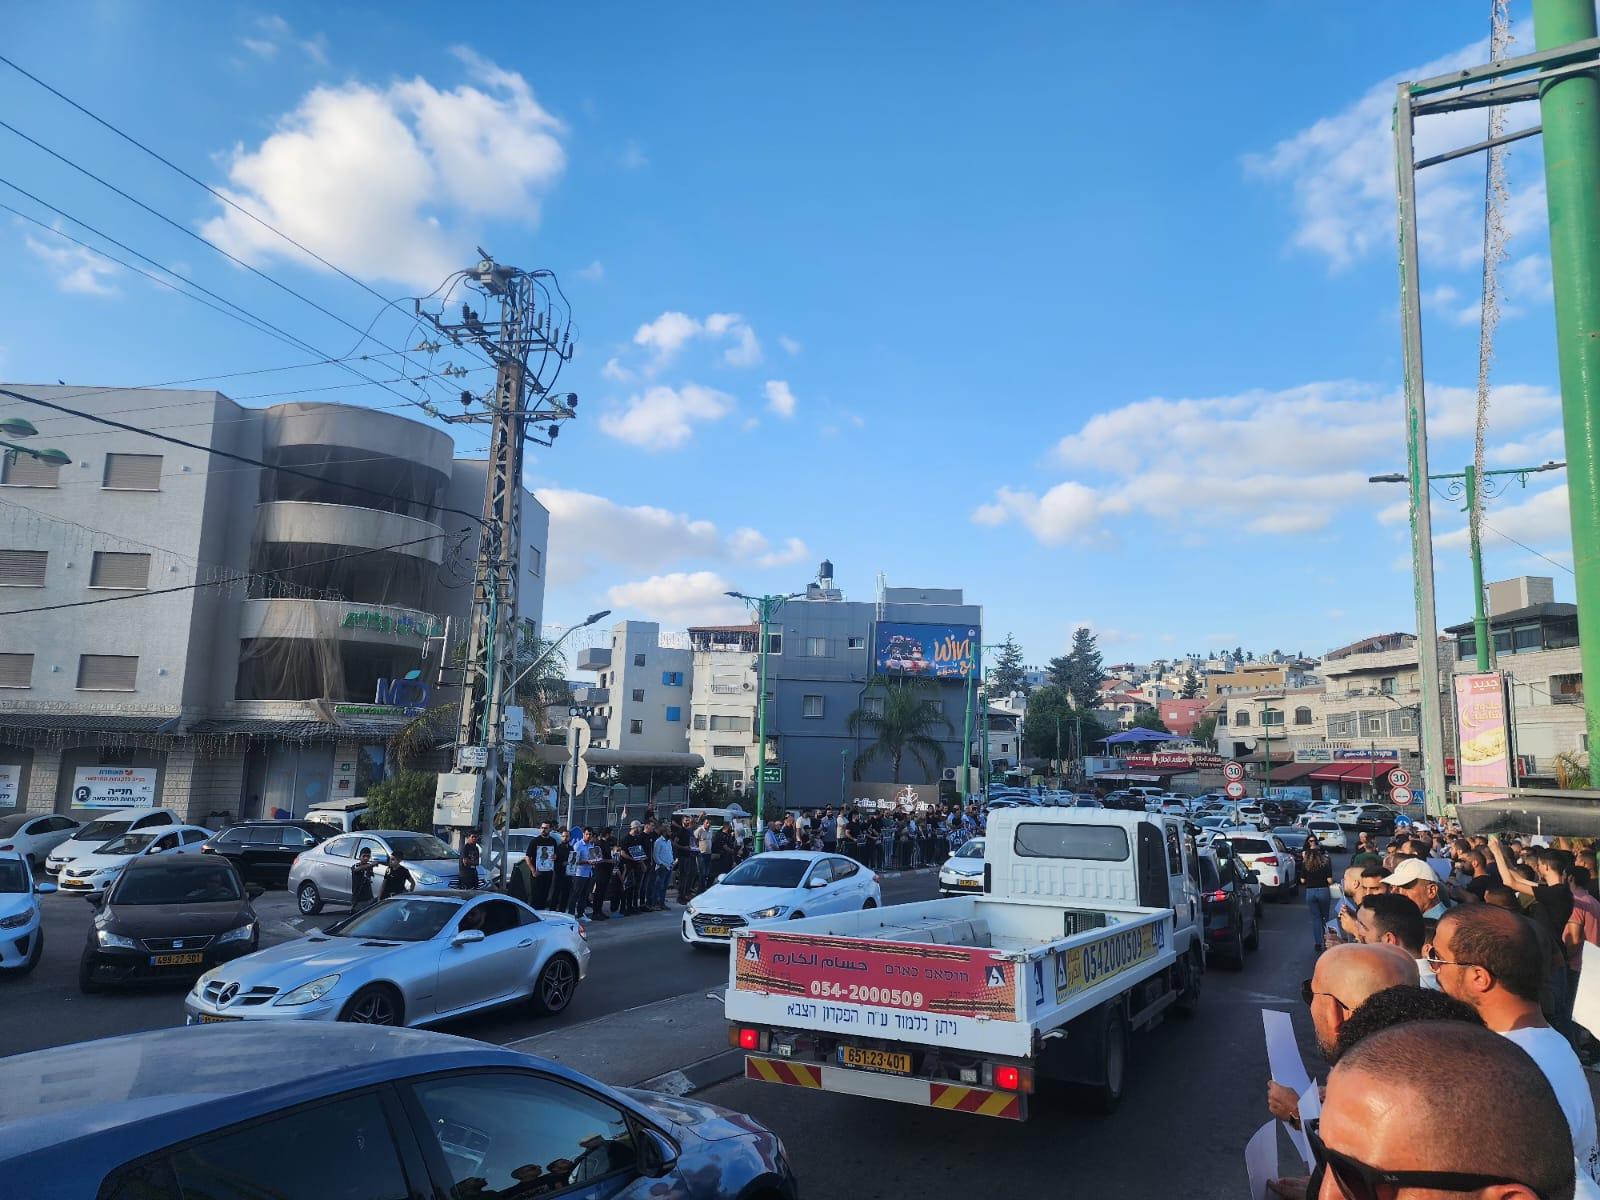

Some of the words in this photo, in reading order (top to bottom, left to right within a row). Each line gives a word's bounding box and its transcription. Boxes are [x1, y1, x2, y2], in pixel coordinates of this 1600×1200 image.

[934, 634, 970, 662] Win
[1473, 679, 1498, 691] جديد
[1228, 767, 1240, 776] 30
[1392, 773, 1406, 783] 30
[107, 787, 133, 796] חנייה
[772, 951, 818, 966] الكارم
[821, 956, 868, 971] حسام
[1083, 928, 1142, 984] 0542000509
[884, 964, 919, 977] כארם
[925, 967, 970, 983] חוסאם
[810, 980, 923, 1008] 054-2000509
[787, 1002, 817, 1018] הצבא
[823, 1005, 859, 1023] הפקדון
[894, 1013, 929, 1032] ללמוד
[935, 1019, 958, 1036] ניתן
